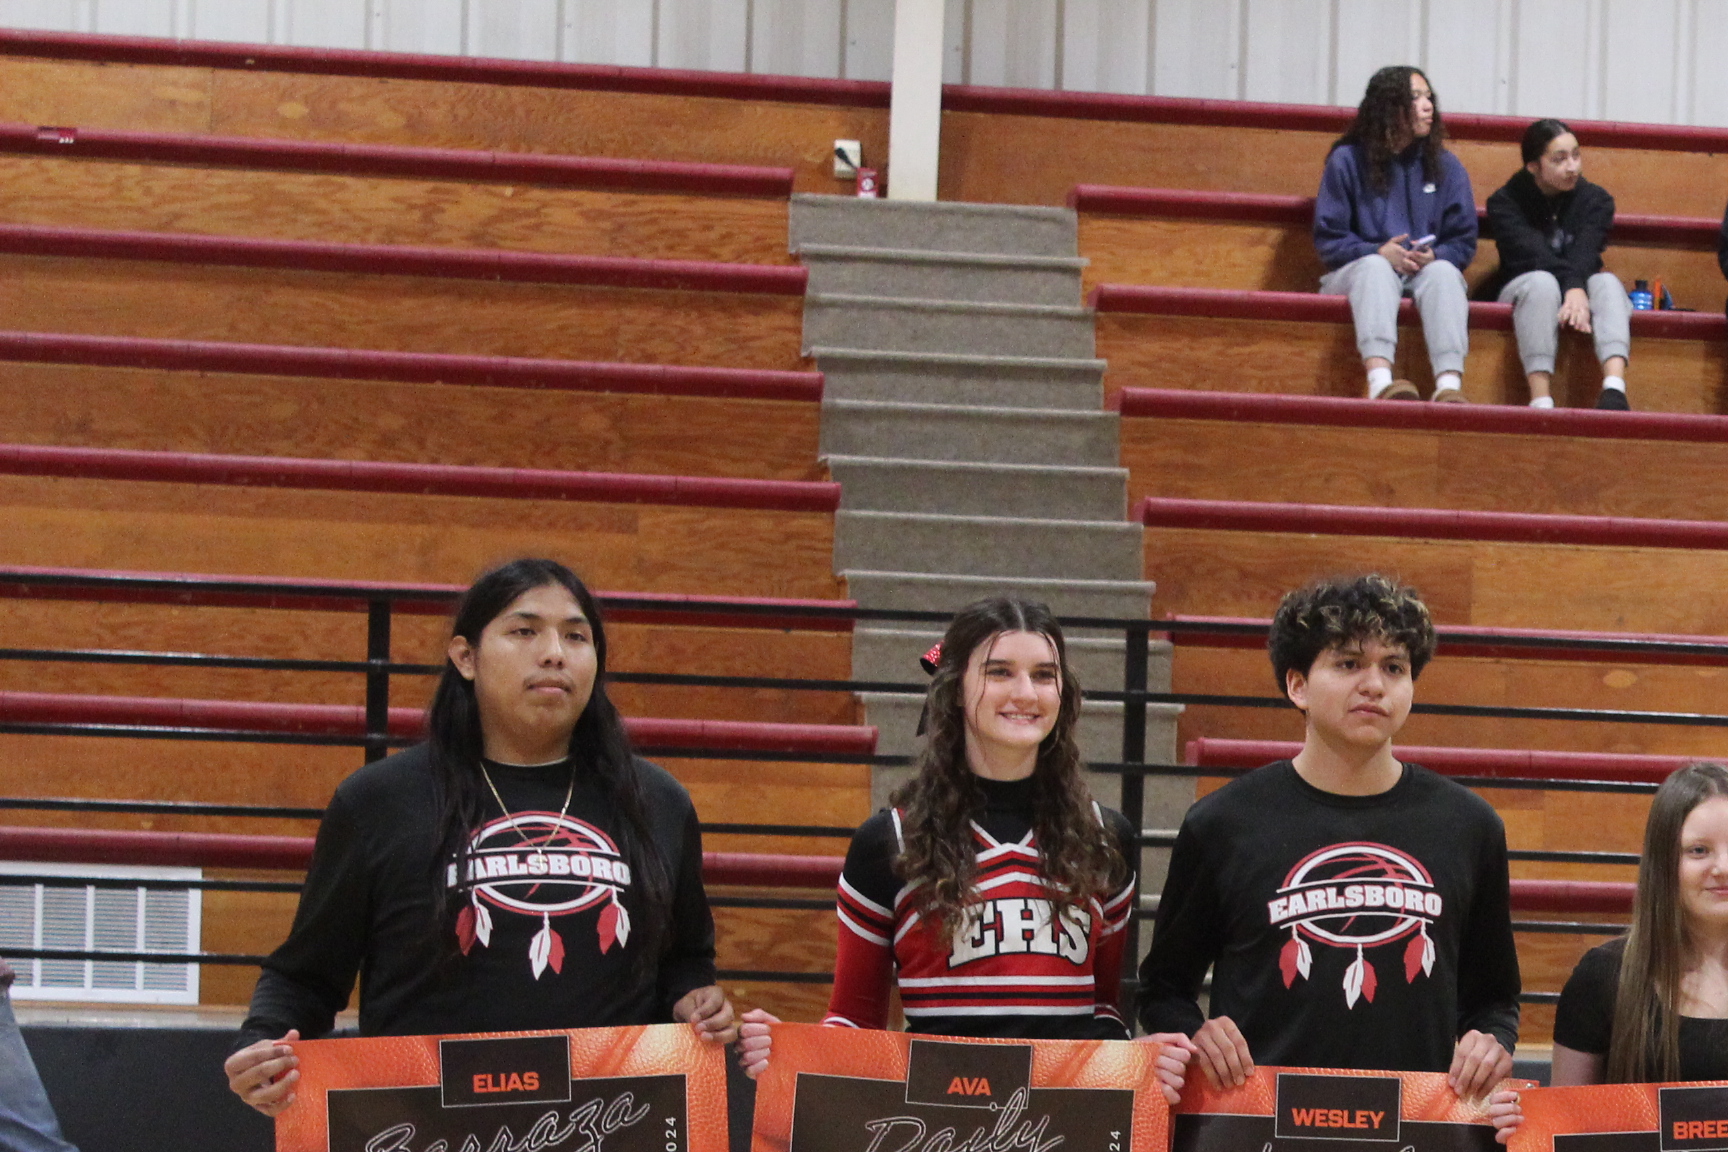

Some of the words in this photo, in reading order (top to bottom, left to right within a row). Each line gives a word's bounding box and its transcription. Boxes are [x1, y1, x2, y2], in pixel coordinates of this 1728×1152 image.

[1268, 884, 1442, 925] EARLSBORO
[948, 897, 1091, 970] EHS
[472, 1072, 540, 1094] ELIAS
[946, 1076, 992, 1096] AVA
[1291, 1107, 1385, 1130] WESLEY
